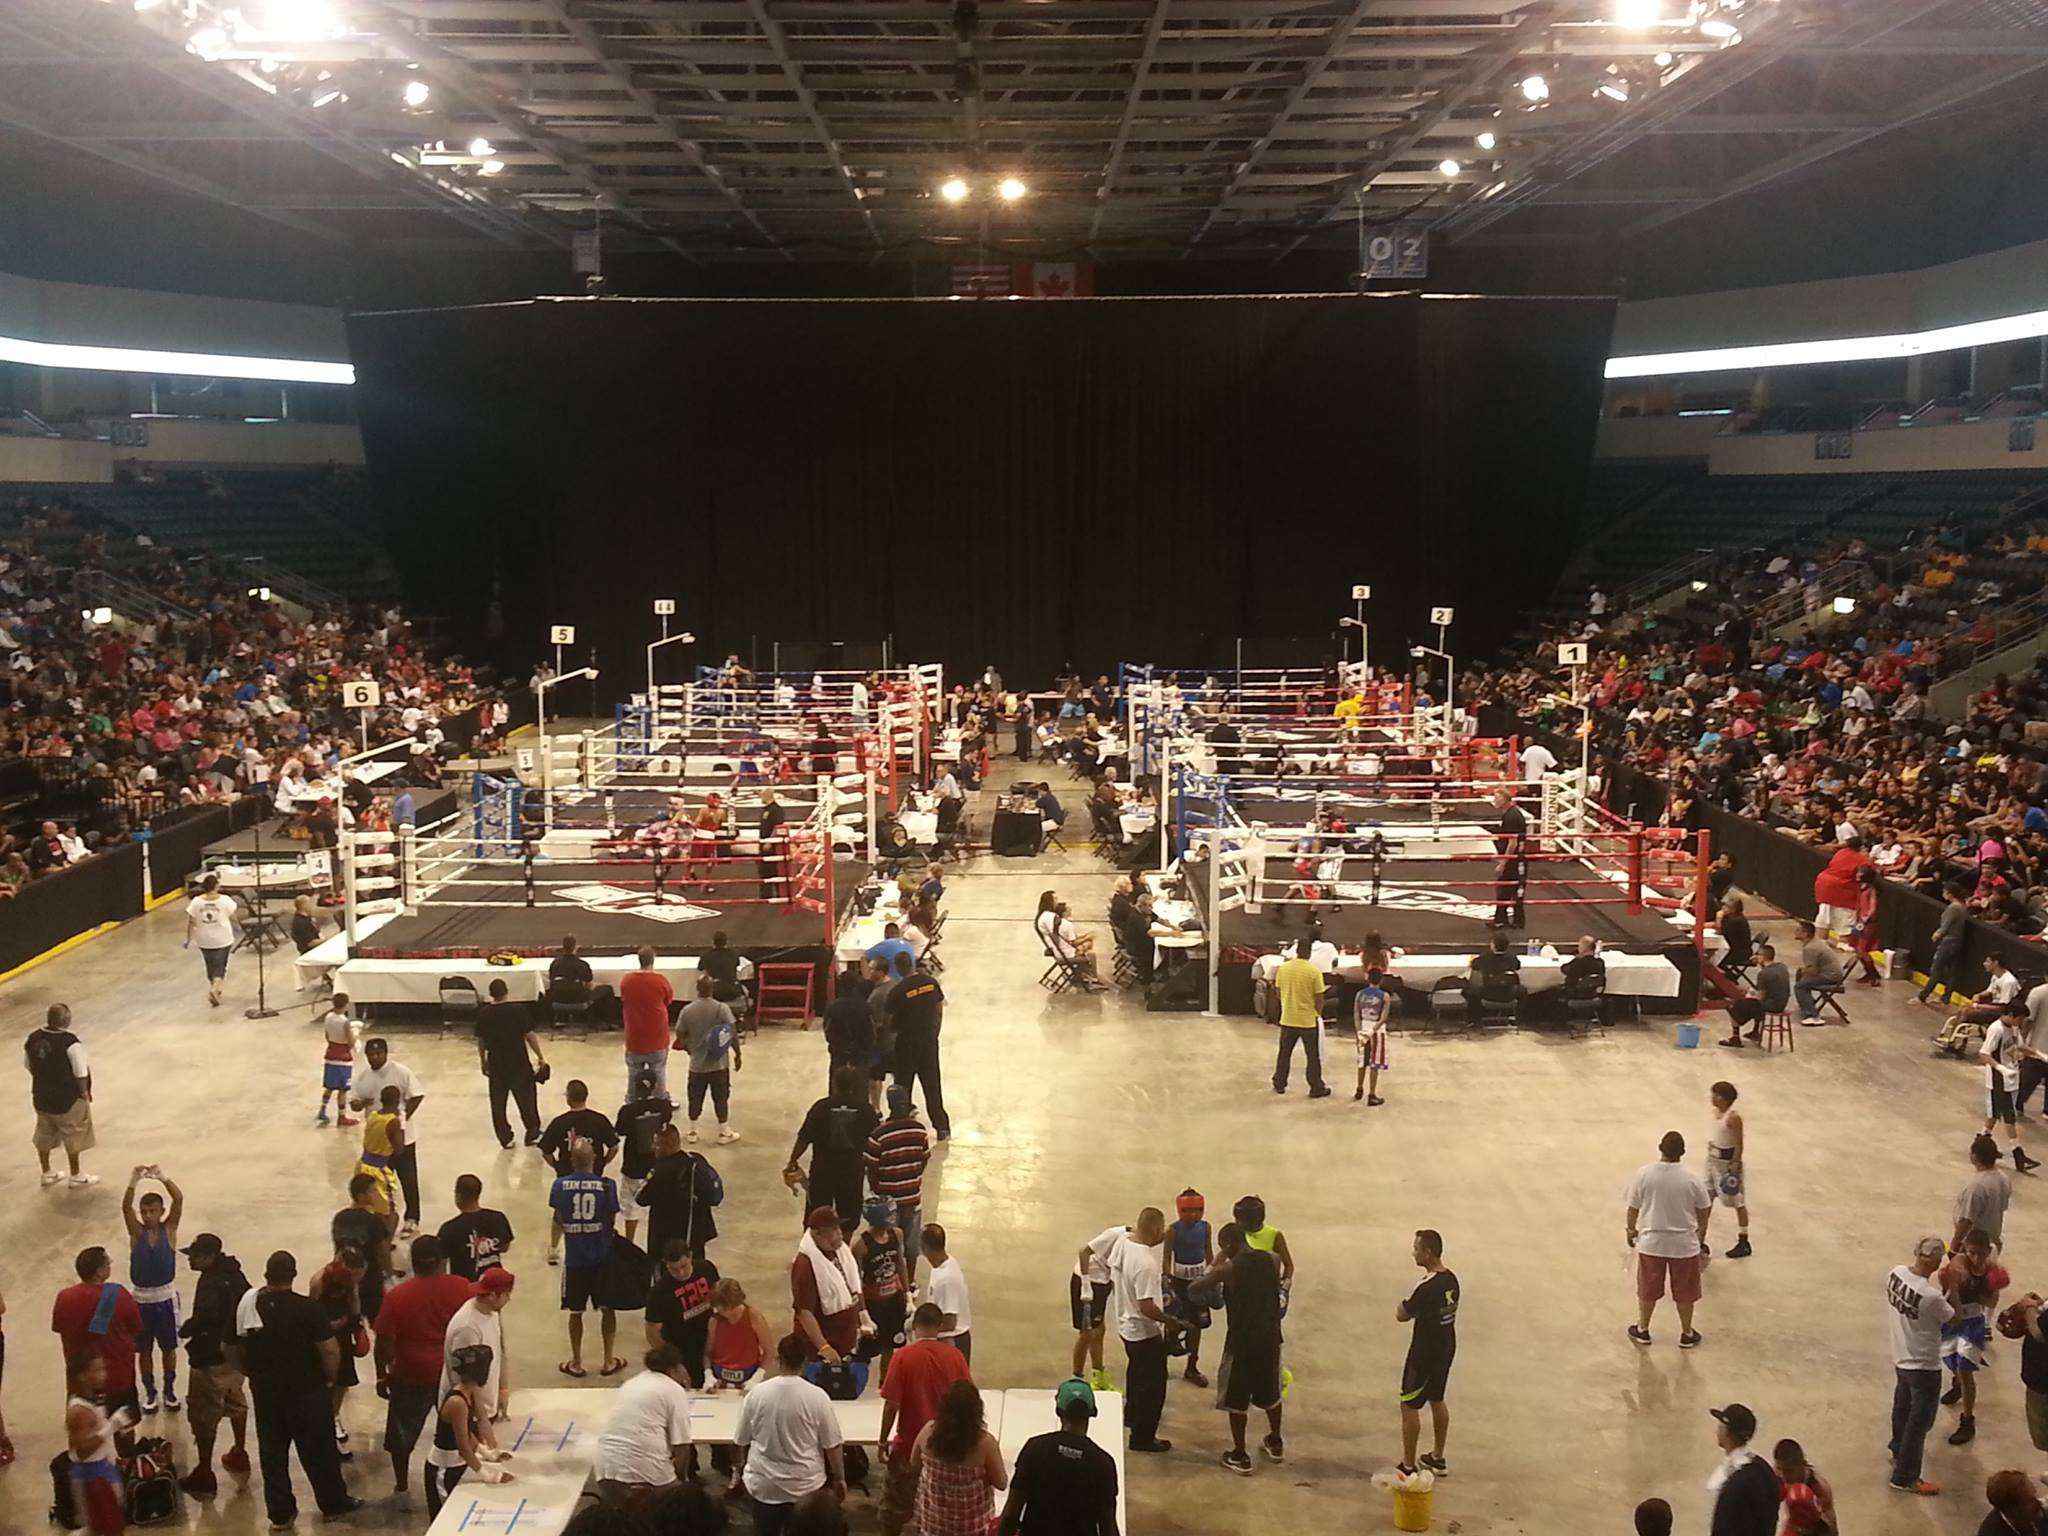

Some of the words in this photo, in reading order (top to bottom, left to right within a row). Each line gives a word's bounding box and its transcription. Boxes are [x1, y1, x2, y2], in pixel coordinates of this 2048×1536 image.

[1356, 588, 1365, 597] 3
[1436, 610, 1446, 622] 2
[558, 628, 568, 641] 5
[1567, 647, 1579, 661] 1
[354, 686, 369, 703] 6
[572, 1192, 596, 1220] 10
[1888, 1272, 1923, 1309] TEAM
